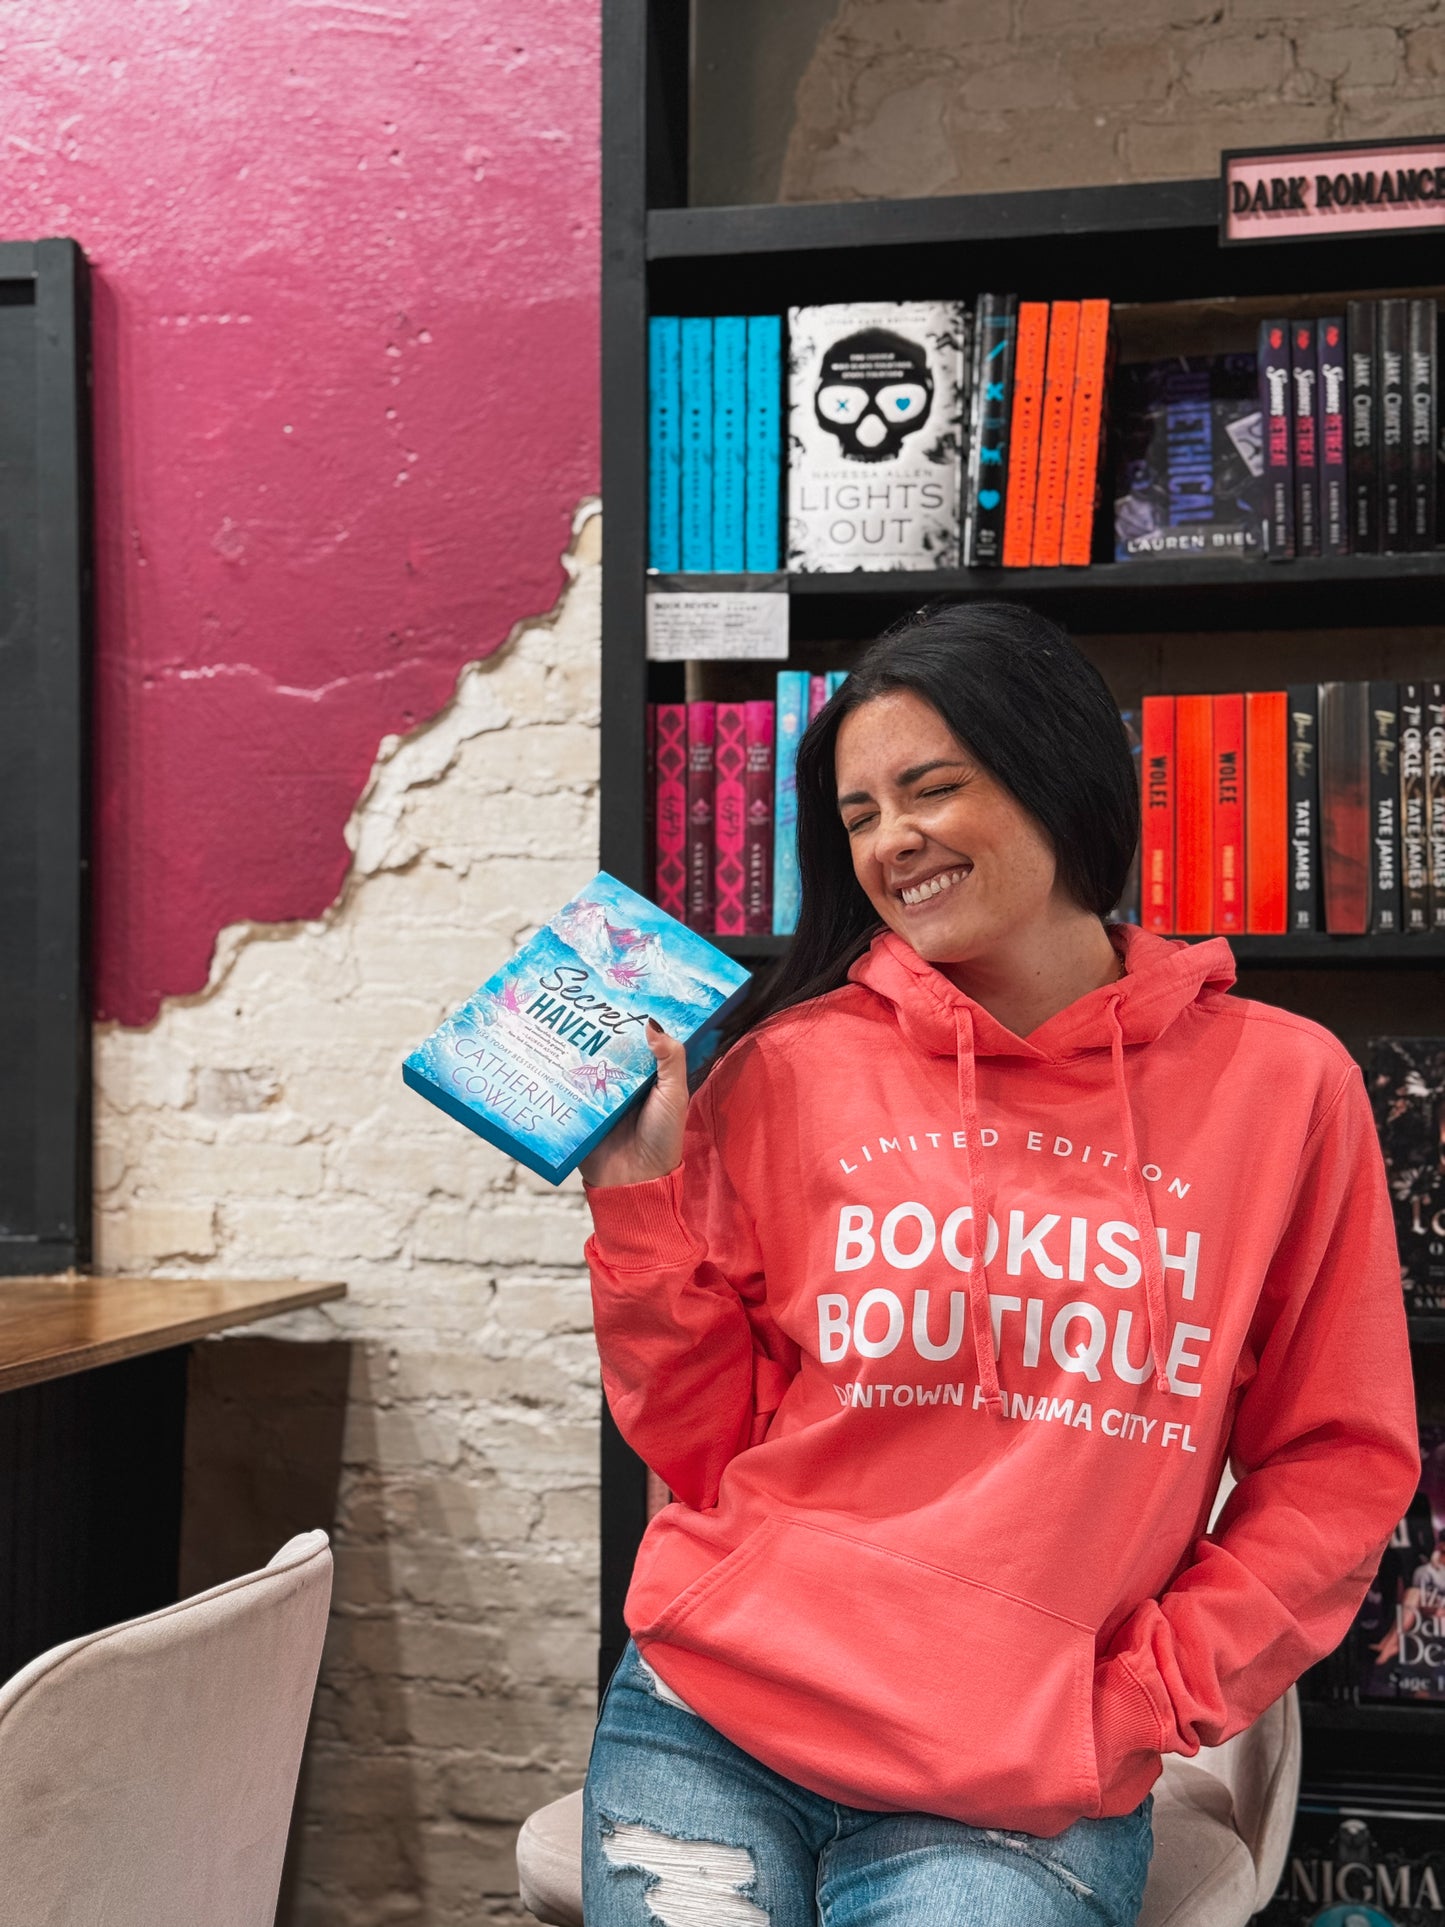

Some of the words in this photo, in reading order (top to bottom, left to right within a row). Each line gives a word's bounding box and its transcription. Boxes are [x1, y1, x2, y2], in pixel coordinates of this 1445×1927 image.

[1232, 177, 1306, 213] DARK
[1315, 167, 1445, 208] ROMANCE
[801, 483, 944, 511] LIGHTS
[830, 519, 912, 544] OUT
[1127, 535, 1205, 552] LAUREN
[1212, 532, 1256, 547] BIEL
[1403, 728, 1422, 777] CIRCLE
[1428, 727, 1445, 777] CIRCLE
[1296, 800, 1310, 836] TATE
[1379, 798, 1393, 835] TATE
[1407, 798, 1421, 835] TATE
[1432, 797, 1445, 835] TATE
[1292, 839, 1310, 890] JAMES
[1376, 839, 1393, 890] JAMES
[1403, 838, 1422, 889] JAMES
[1429, 838, 1445, 889] JAMES
[525, 992, 612, 1057] HAVEN
[539, 967, 649, 1034] Secret
[454, 1037, 578, 1127] CATHERINE
[475, 1029, 489, 1040] USA
[489, 1038, 512, 1055] TODAY
[511, 1053, 554, 1083] BESTSELLING
[553, 1081, 584, 1103] AUTHOR
[451, 1065, 544, 1133] COWLES
[838, 1128, 999, 1175] LIMITED
[1026, 1130, 1191, 1200] EDITON
[834, 1201, 1200, 1301] BOOKISH
[816, 1288, 1211, 1398] BOUTIQUE
[1101, 1408, 1158, 1444] CITY
[1161, 1421, 1197, 1453] FL
[1273, 1858, 1444, 1911] NIGMA
